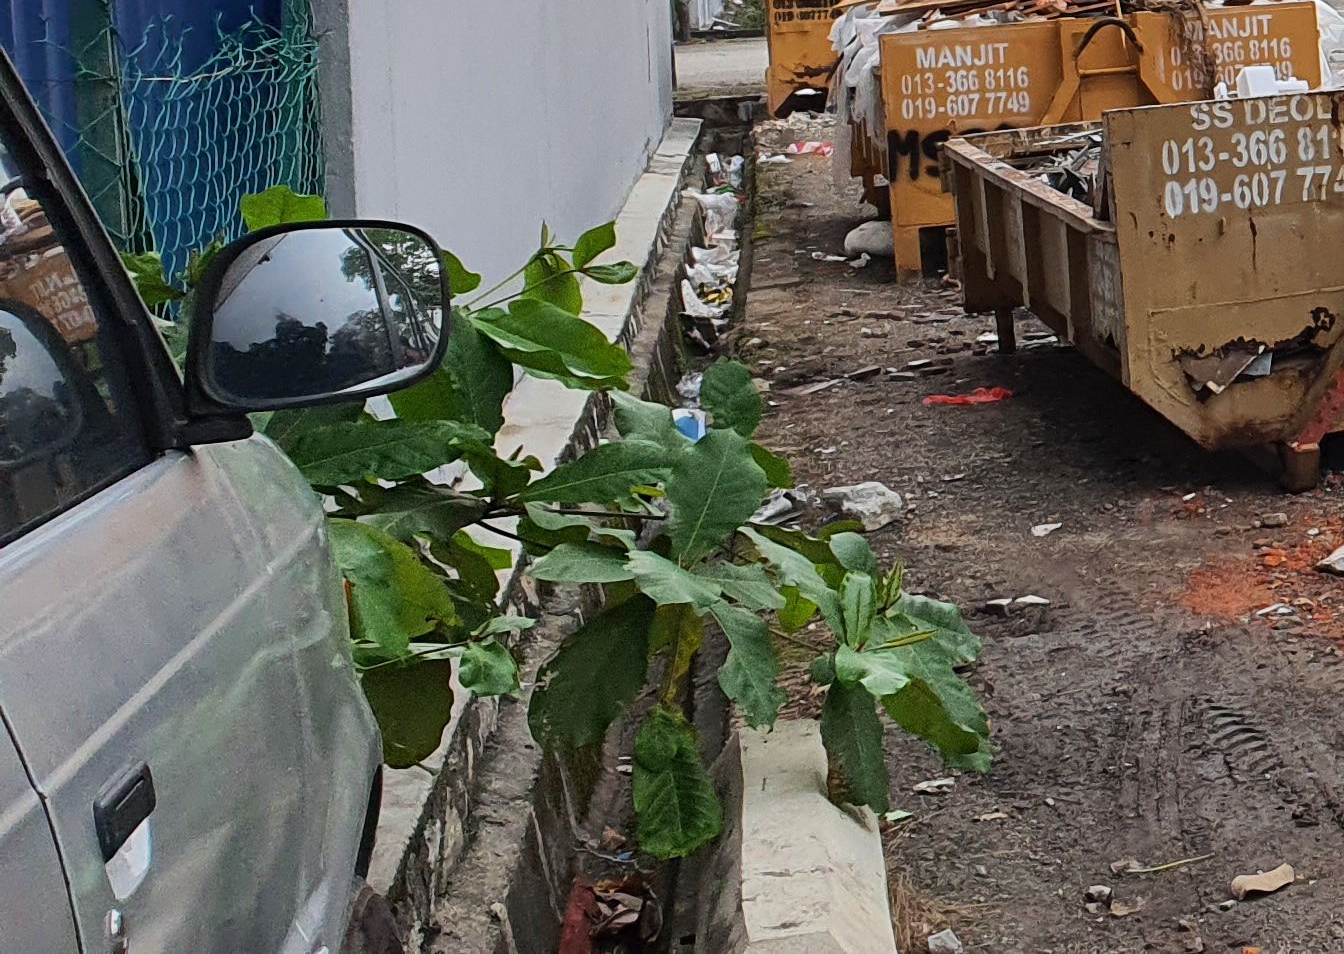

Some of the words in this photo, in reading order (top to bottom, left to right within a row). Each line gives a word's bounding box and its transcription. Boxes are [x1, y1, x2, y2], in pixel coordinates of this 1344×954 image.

[915, 43, 1009, 69] MANJIT
[1250, 37, 1291, 60] 8116
[901, 69, 979, 95] 013-366
[985, 66, 1029, 90] 8116
[901, 93, 980, 120] 019-607
[985, 91, 1030, 114] 7749
[1190, 102, 1234, 131] SS
[1244, 95, 1333, 125] DEOL
[1162, 128, 1287, 175] 013-366
[1164, 170, 1287, 219] 019-607
